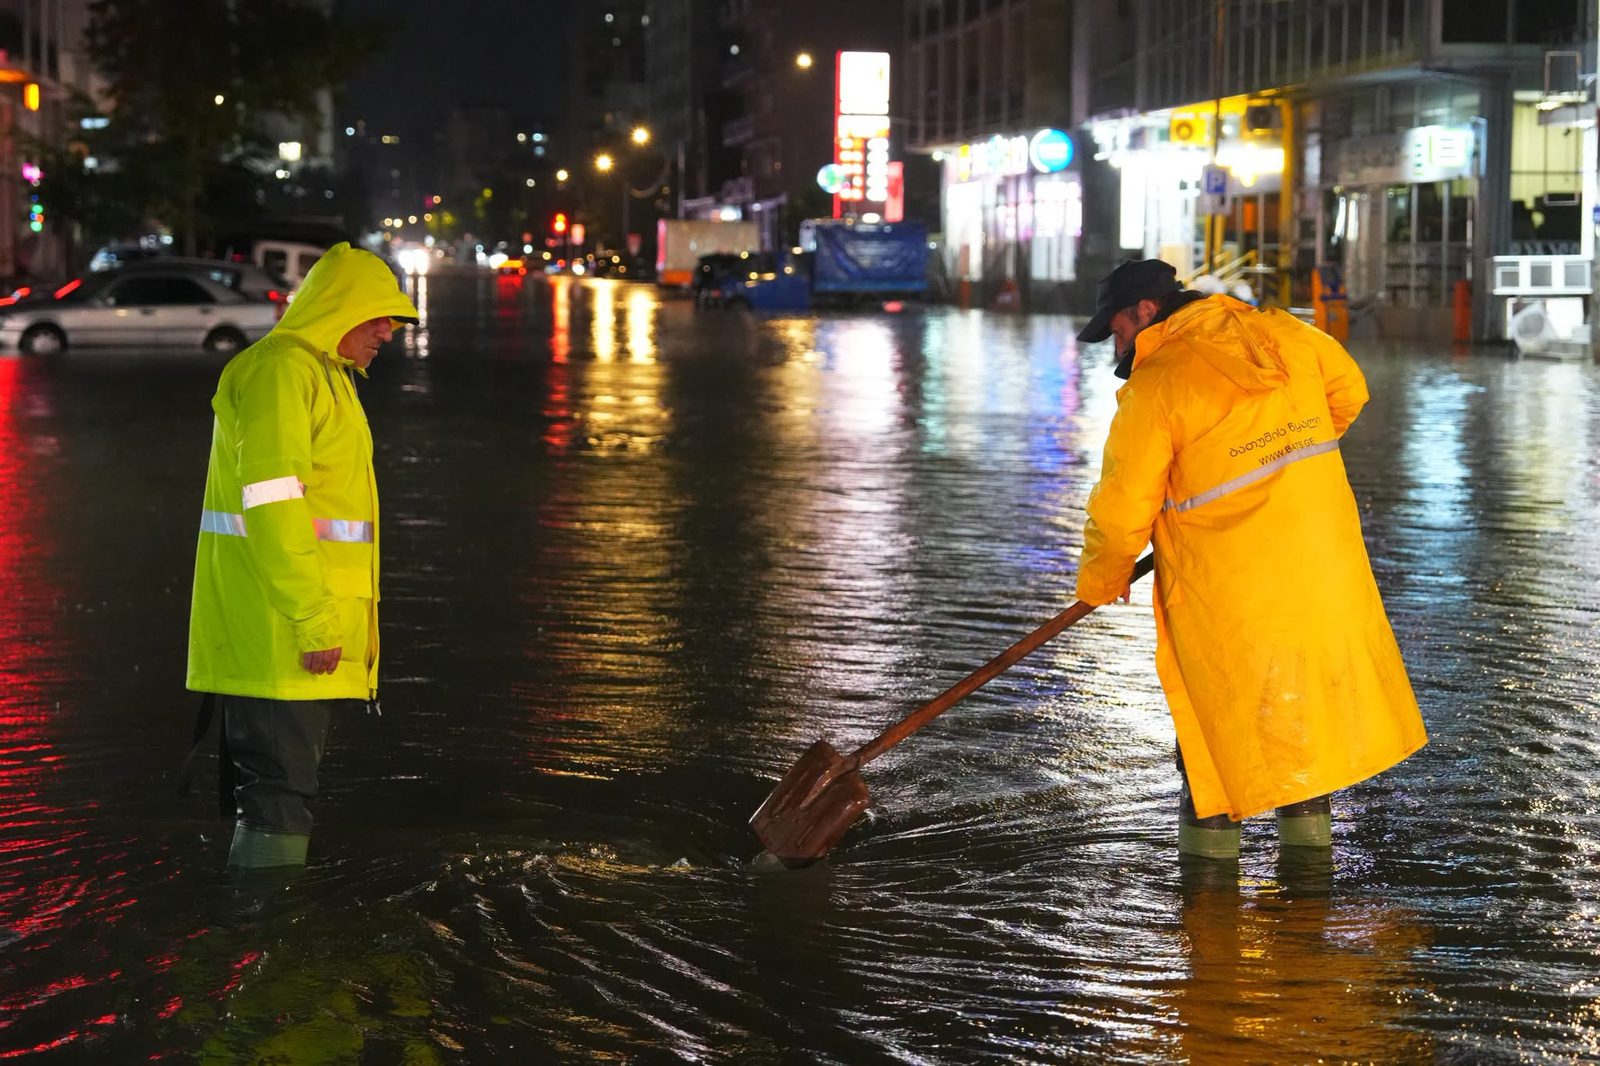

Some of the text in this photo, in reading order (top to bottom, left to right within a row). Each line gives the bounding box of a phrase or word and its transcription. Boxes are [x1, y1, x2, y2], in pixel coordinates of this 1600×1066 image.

[1210, 173, 1223, 192] P
[1229, 416, 1322, 458] ბათუმის წყალი
